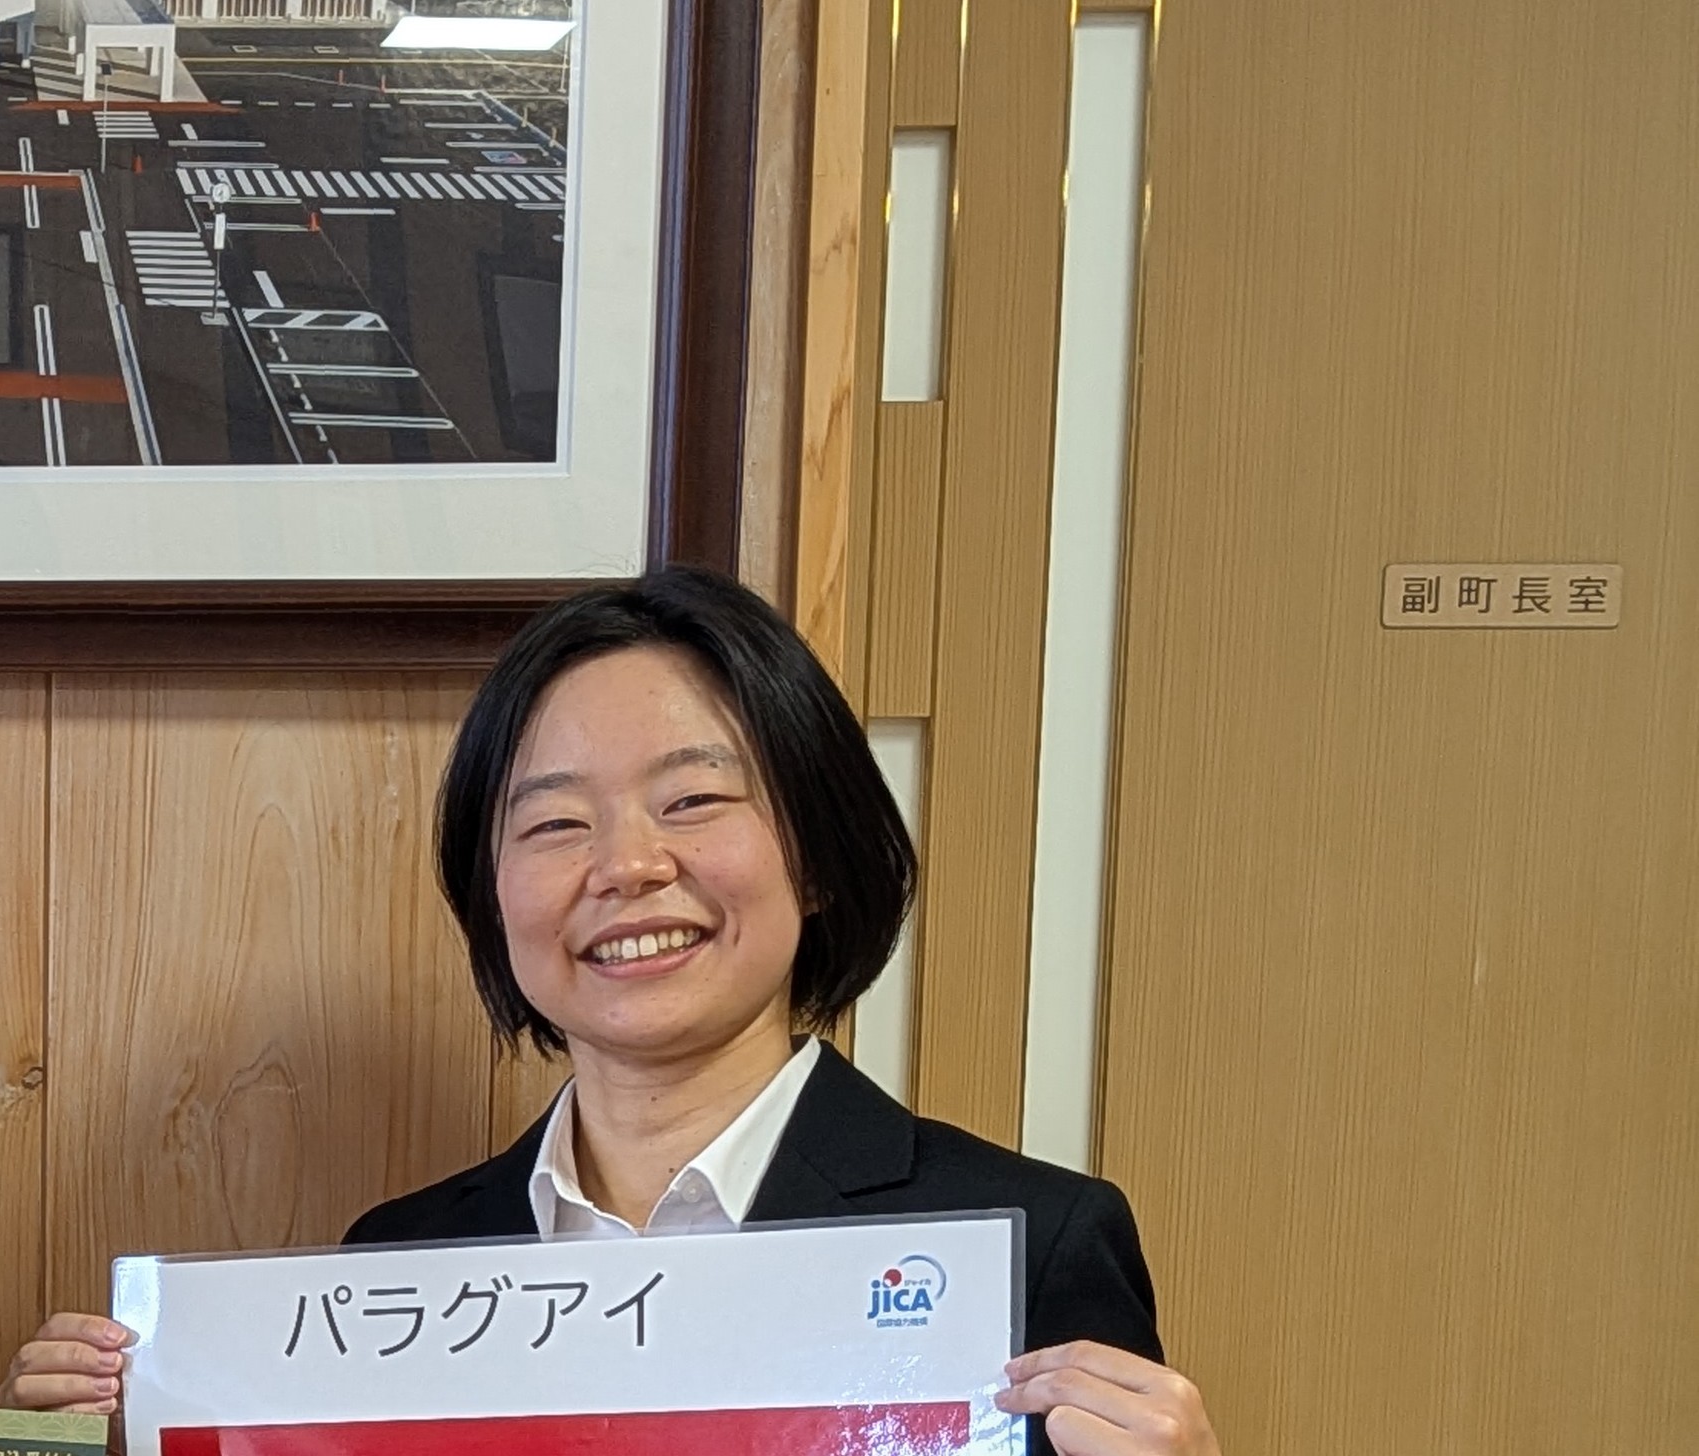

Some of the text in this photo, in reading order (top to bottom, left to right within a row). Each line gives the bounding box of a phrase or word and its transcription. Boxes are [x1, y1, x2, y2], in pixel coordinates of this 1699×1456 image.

[1401, 575, 1608, 614] 副町長室
[284, 1271, 665, 1358] パラグアイ
